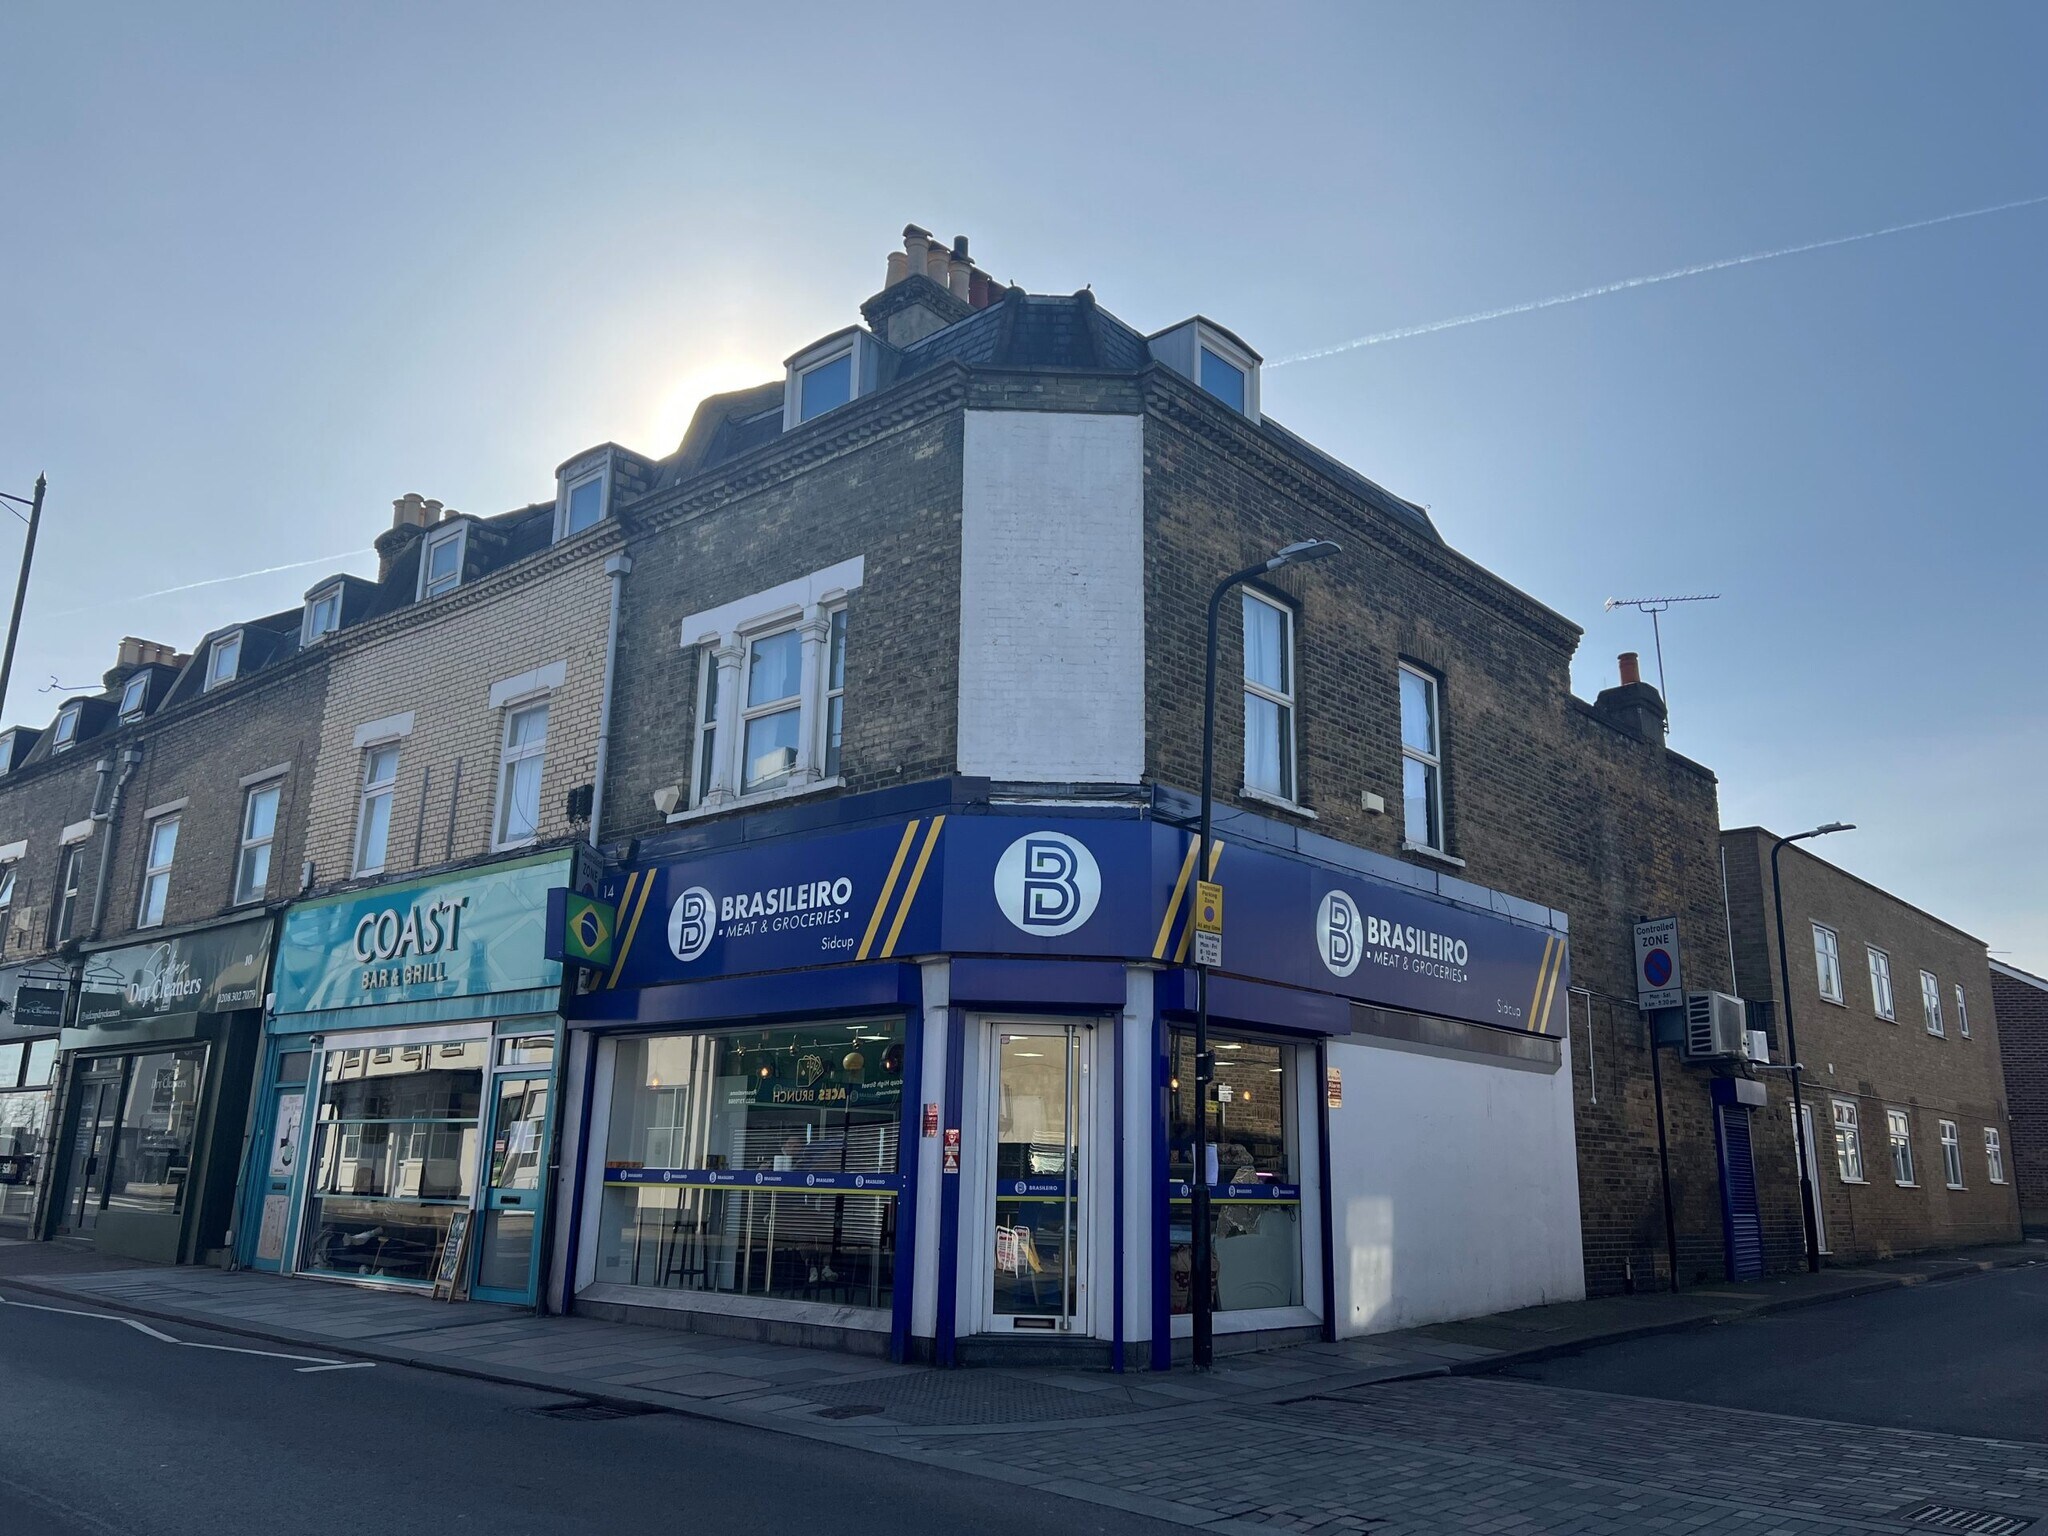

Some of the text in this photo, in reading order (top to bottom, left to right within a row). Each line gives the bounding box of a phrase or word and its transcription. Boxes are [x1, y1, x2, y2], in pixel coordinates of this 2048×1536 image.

[583, 863, 598, 883] ZONE
[1023, 839, 1081, 926] B
[603, 884, 614, 899] 14
[721, 877, 852, 921] BRASILEIRO
[353, 896, 470, 963] COAST
[726, 909, 841, 938] MEAT & GROCERIES
[1636, 922, 1674, 935] Controlled
[821, 935, 854, 950] Sidcup
[1367, 916, 1468, 966] BRASILEIRO
[1642, 934, 1669, 947] ZONE
[244, 954, 253, 966] 10
[1373, 951, 1462, 982] MEAT & GROCERIES
[362, 961, 448, 990] BAR & GRILL
[128, 983, 151, 1008] Dry
[152, 977, 202, 1000] Cleaners
